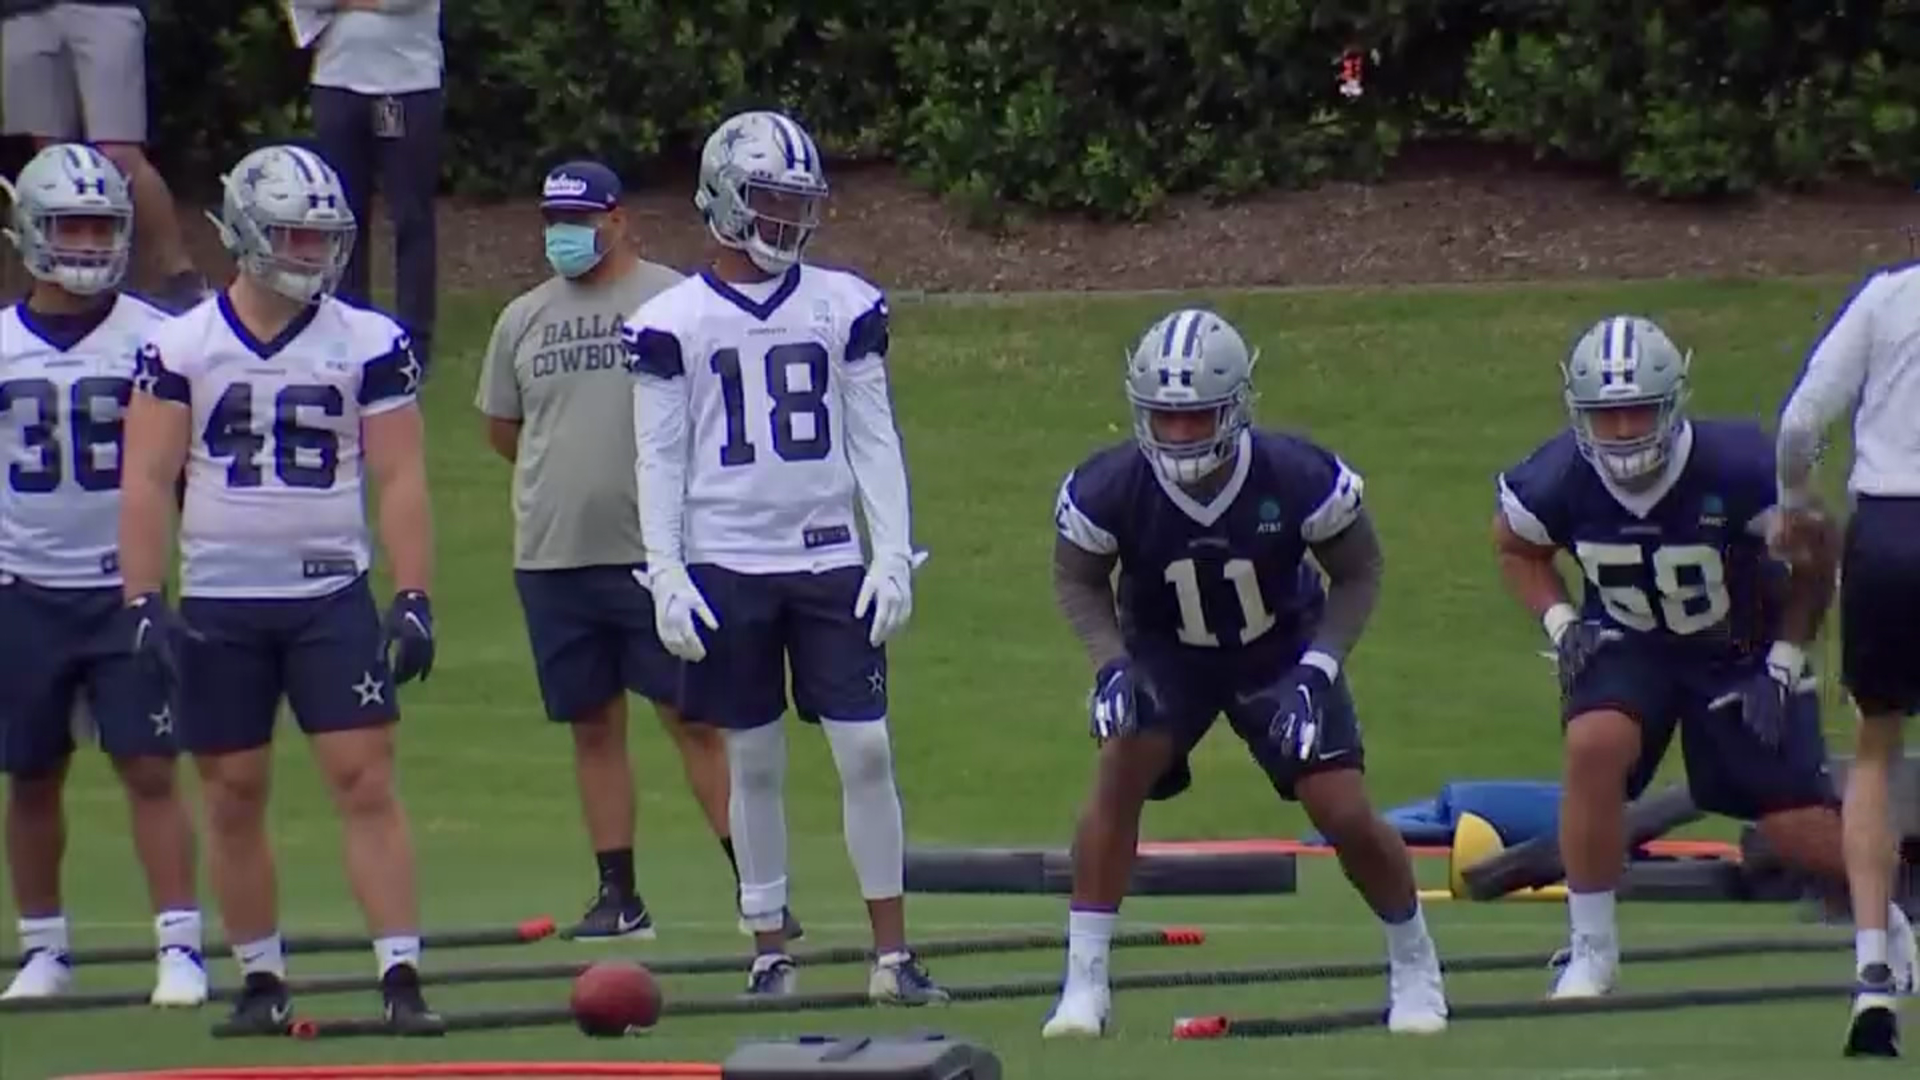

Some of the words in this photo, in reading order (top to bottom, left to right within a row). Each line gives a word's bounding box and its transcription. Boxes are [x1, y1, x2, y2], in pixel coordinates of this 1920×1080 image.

[533, 343, 632, 378] COWBOY
[542, 312, 624, 350] DALLA
[0, 378, 133, 493] 36
[202, 382, 343, 489] 46
[710, 341, 831, 466] 18
[1164, 558, 1277, 648] 11
